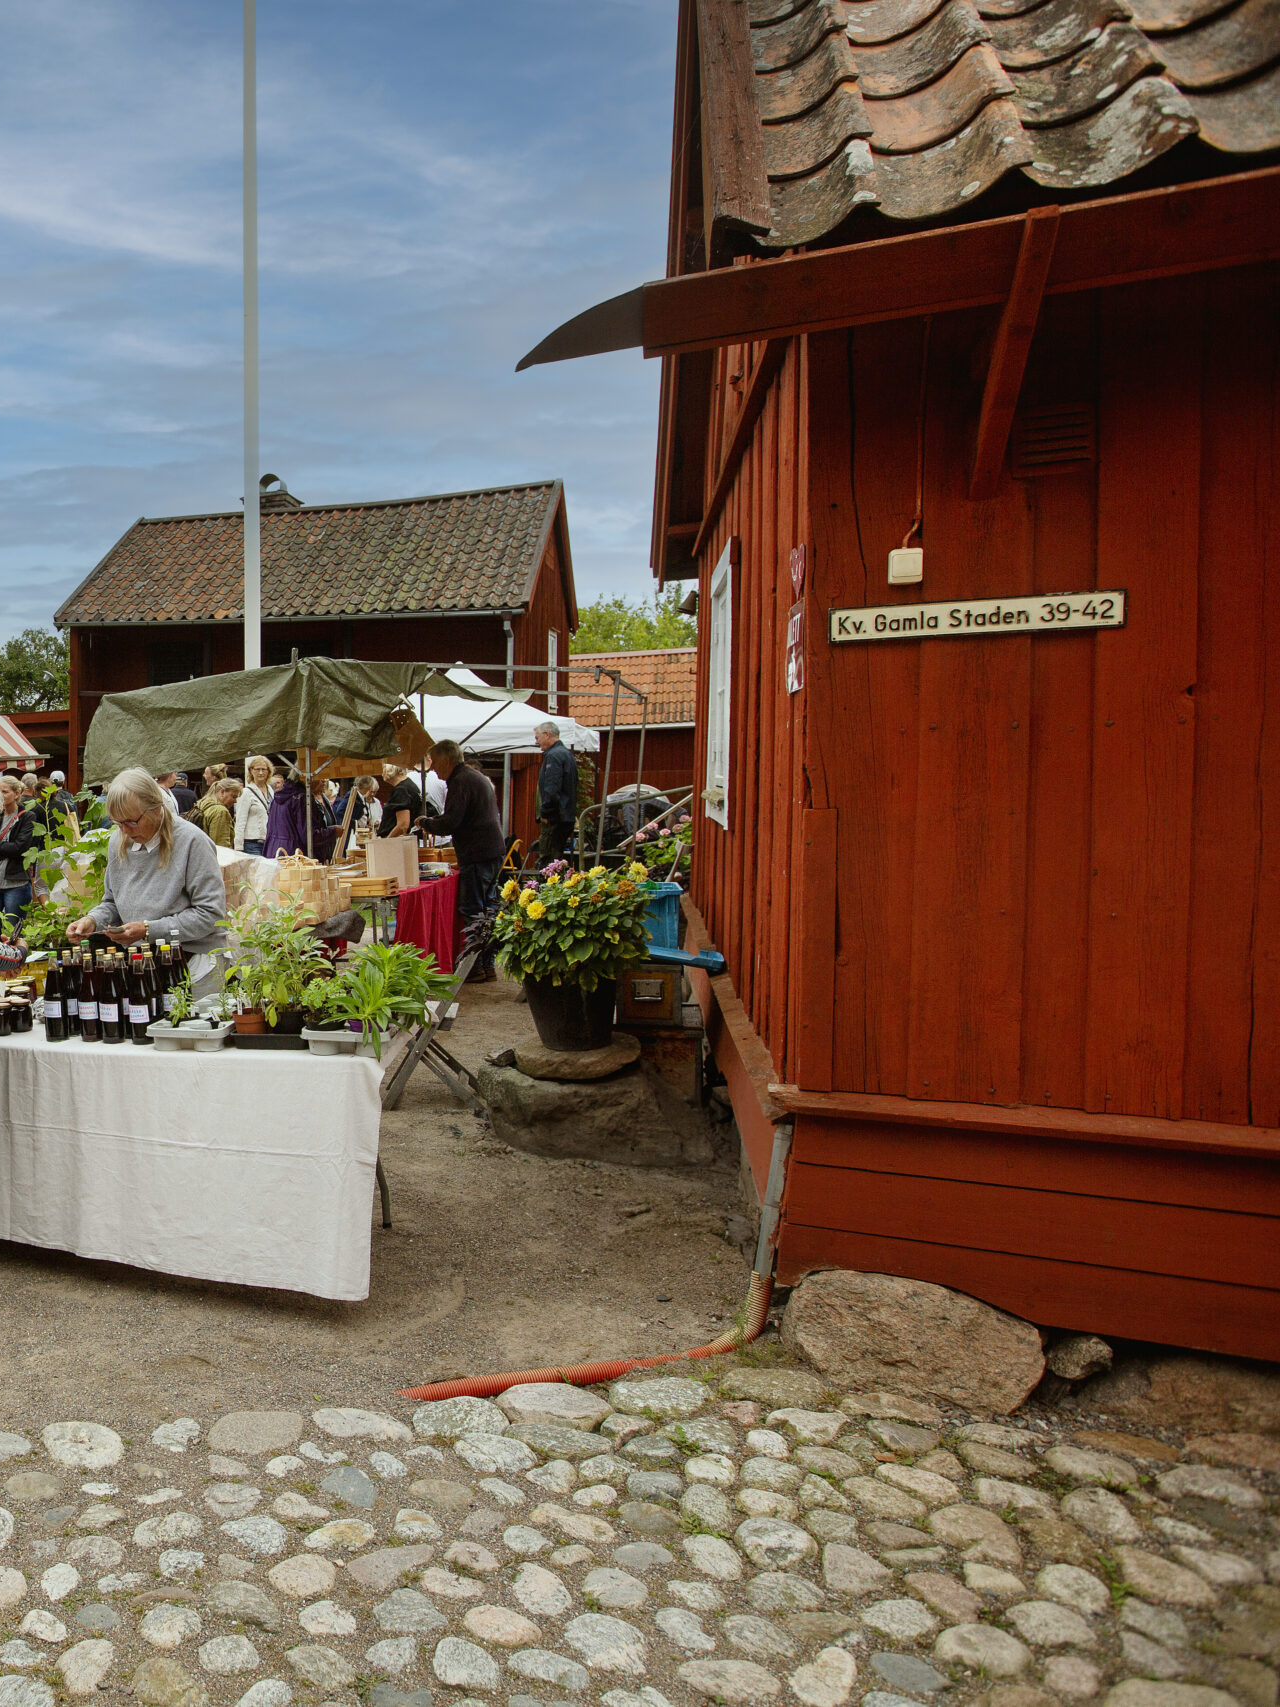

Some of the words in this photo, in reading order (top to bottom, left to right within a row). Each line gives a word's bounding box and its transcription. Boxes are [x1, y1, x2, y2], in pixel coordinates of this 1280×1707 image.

[837, 615, 867, 635] Kv.
[874, 610, 939, 632] Gamla
[949, 605, 1031, 628] Staden
[1040, 599, 1115, 622] 39-42
